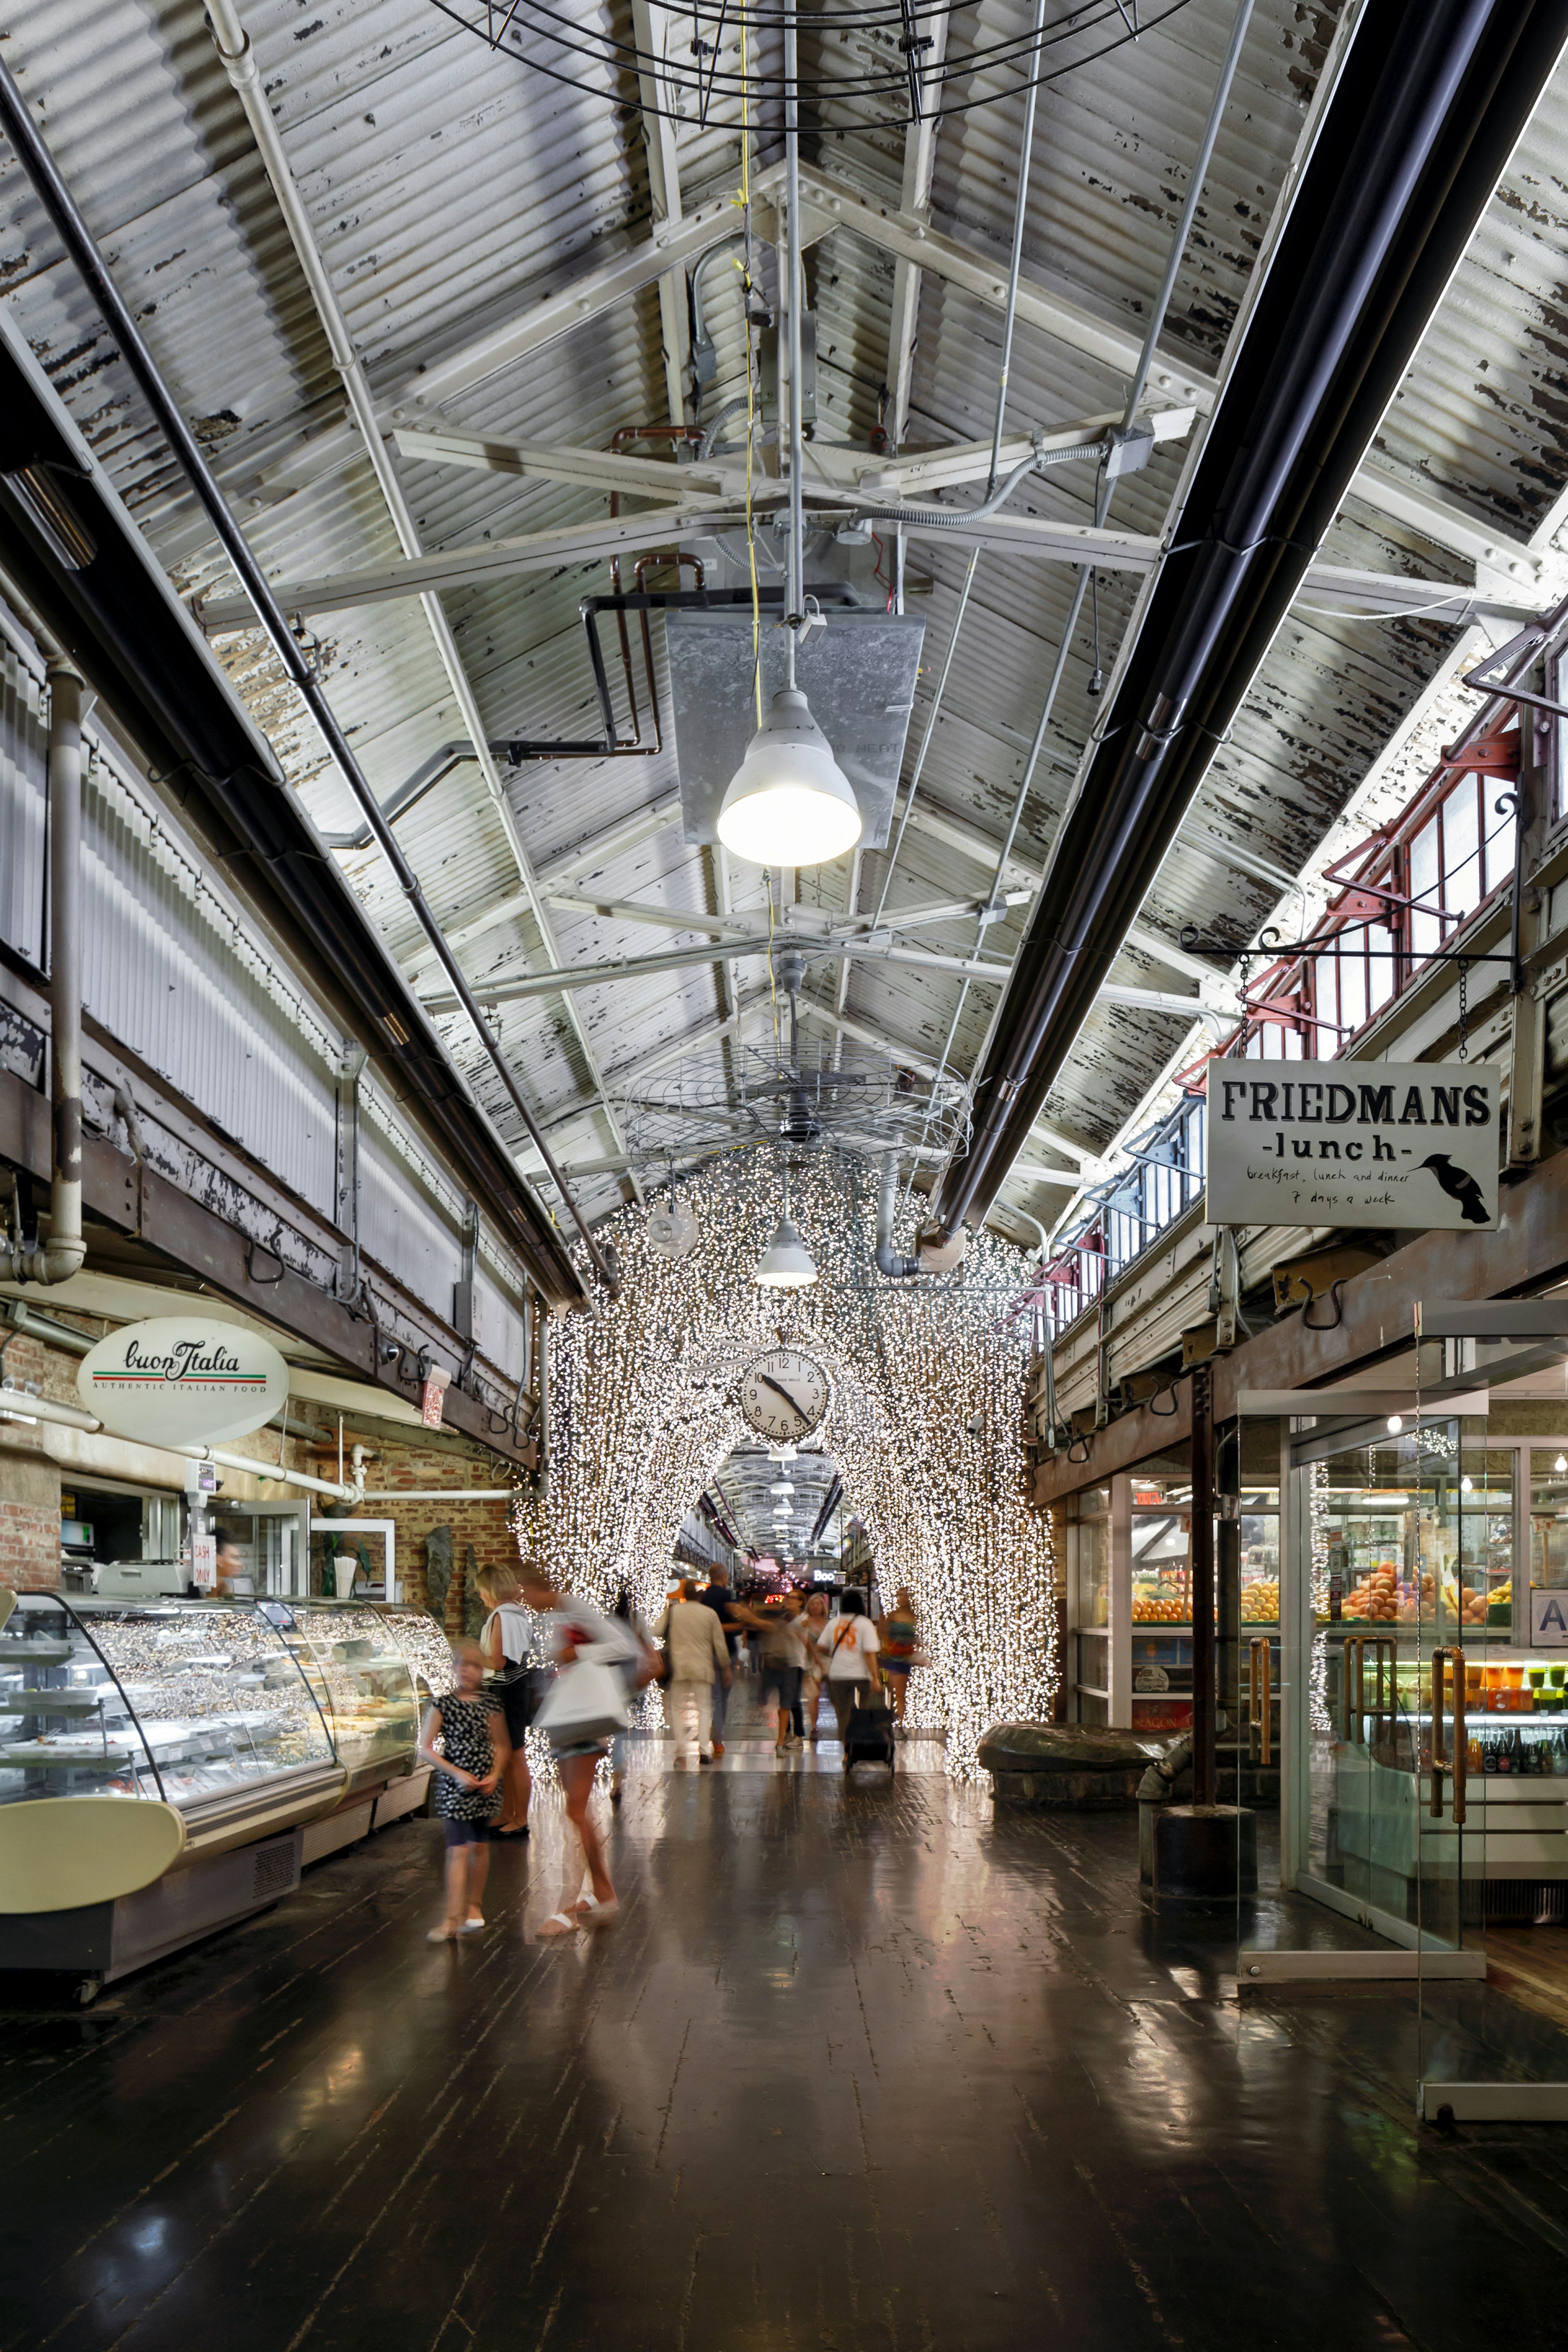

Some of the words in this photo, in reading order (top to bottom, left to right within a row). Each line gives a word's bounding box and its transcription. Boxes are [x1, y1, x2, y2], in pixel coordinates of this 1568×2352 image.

[856, 744, 900, 753] HEAT
[1222, 1081, 1491, 1126] FRIEDMANS
[1314, 1169, 1346, 1181] lunch
[1354, 1172, 1371, 1182] and
[1377, 1172, 1410, 1183] dinner
[1292, 1191, 1300, 1204] 7
[1311, 1191, 1338, 1209] days
[1364, 1192, 1395, 1204] week
[768, 1361, 774, 1373] 11
[779, 1358, 789, 1368] 12
[798, 1361, 801, 1372] 1
[755, 1372, 764, 1383] 10
[807, 1372, 815, 1382] 2
[93, 1382, 165, 1390] AUTHENTIC
[173, 1384, 225, 1392] ITALIAN
[750, 1390, 757, 1400] 9
[812, 1389, 819, 1399] 3
[755, 1406, 762, 1417] 8
[806, 1405, 815, 1416] 4
[768, 1416, 776, 1427] 7
[781, 1421, 788, 1431] 6
[794, 1416, 802, 1427] 5
[195, 1545, 209, 1559] CASH
[195, 1568, 210, 1583] ONLY
[814, 1570, 837, 1581] Boo
[1539, 1599, 1567, 1631] A
